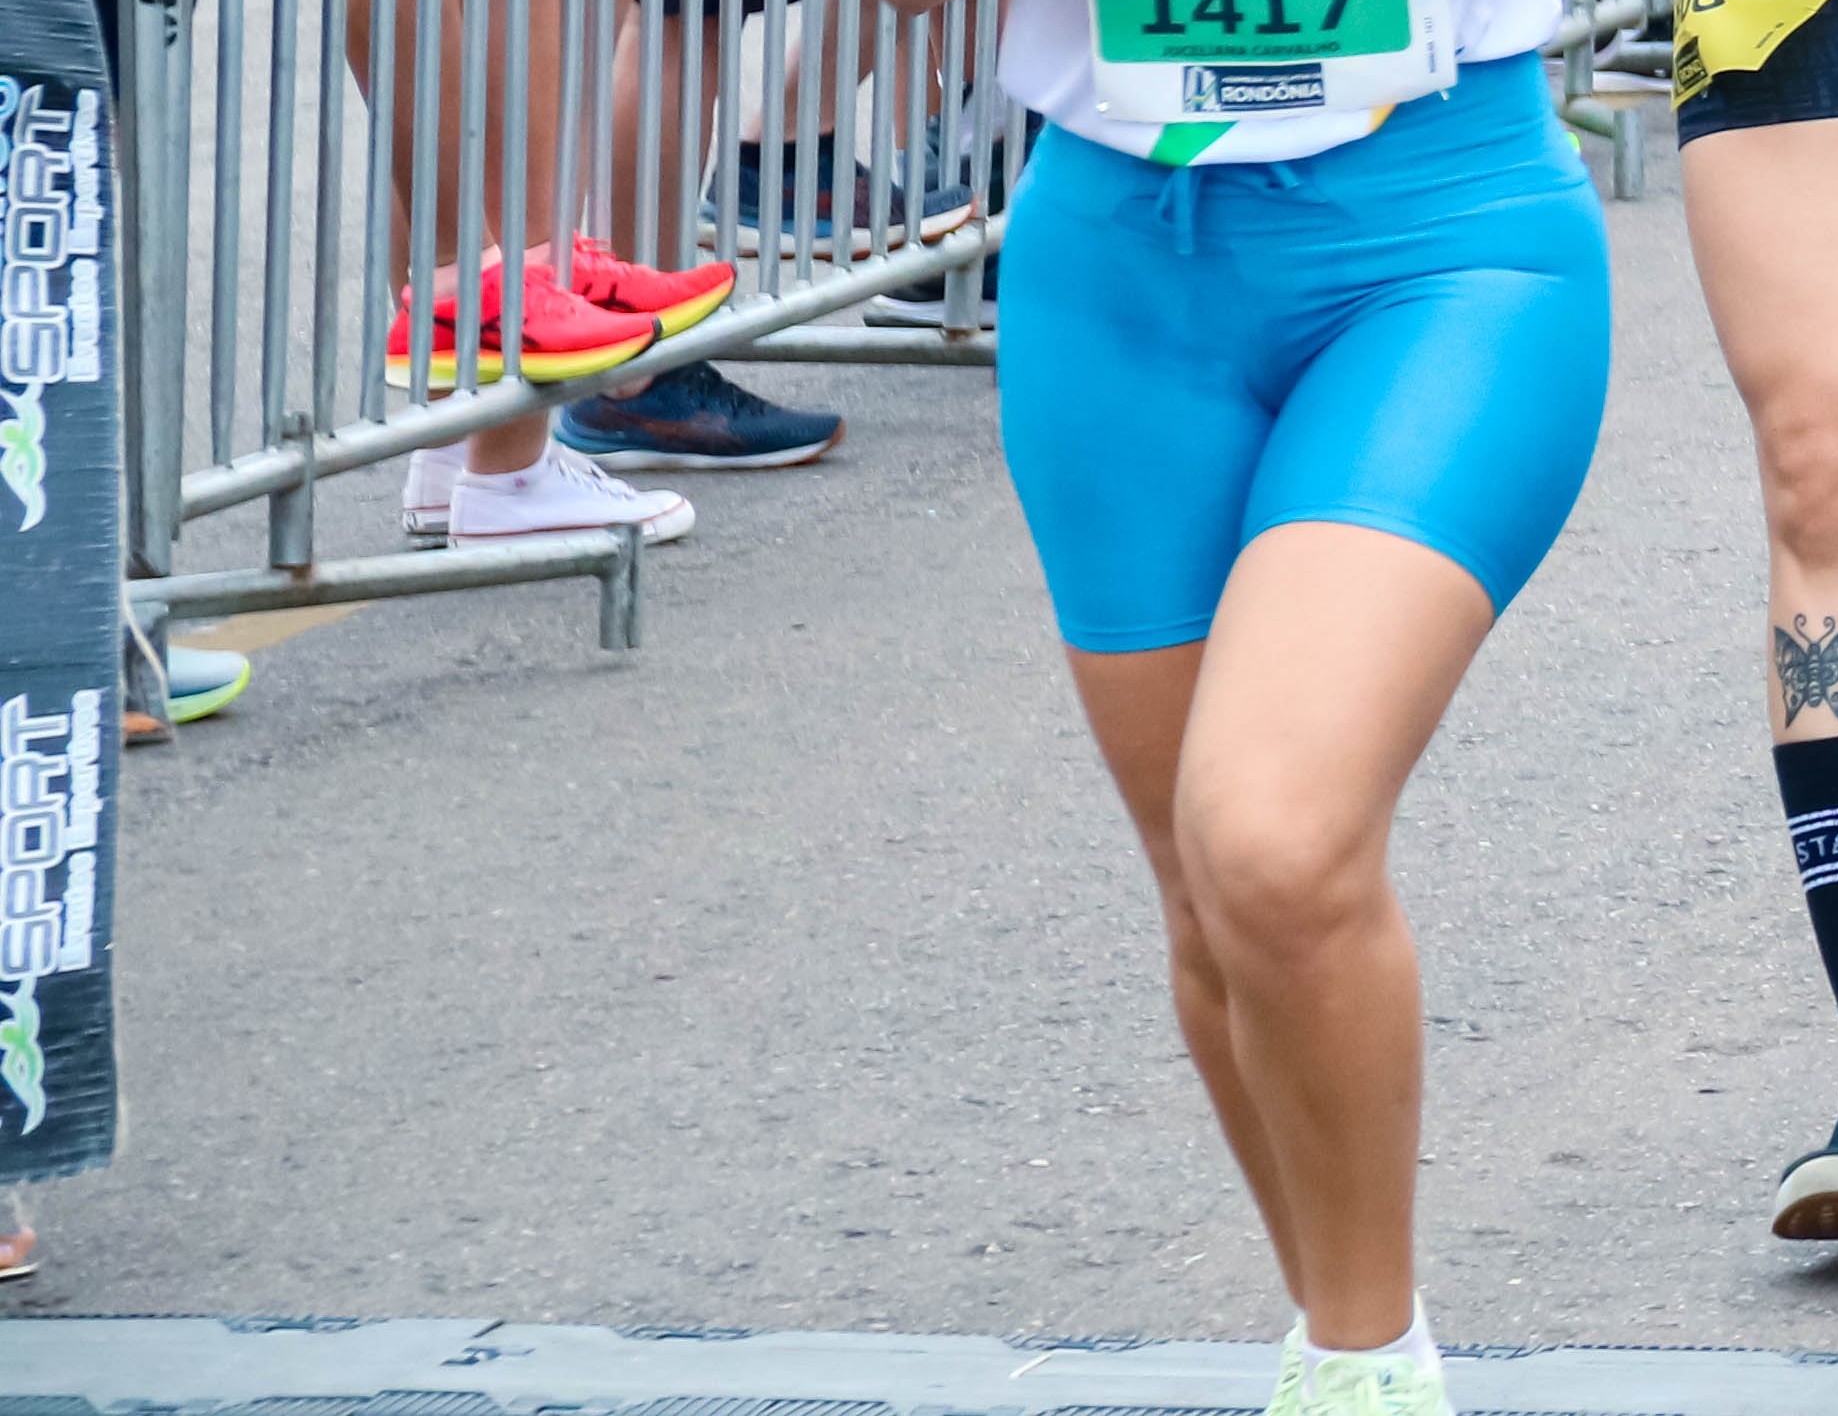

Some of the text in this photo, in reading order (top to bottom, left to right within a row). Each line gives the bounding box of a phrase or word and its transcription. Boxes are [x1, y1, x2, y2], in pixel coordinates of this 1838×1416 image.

[2, 85, 72, 383] SPORT
[1221, 81, 1323, 104] RONDÔNIA
[0, 692, 69, 981] SPORT
